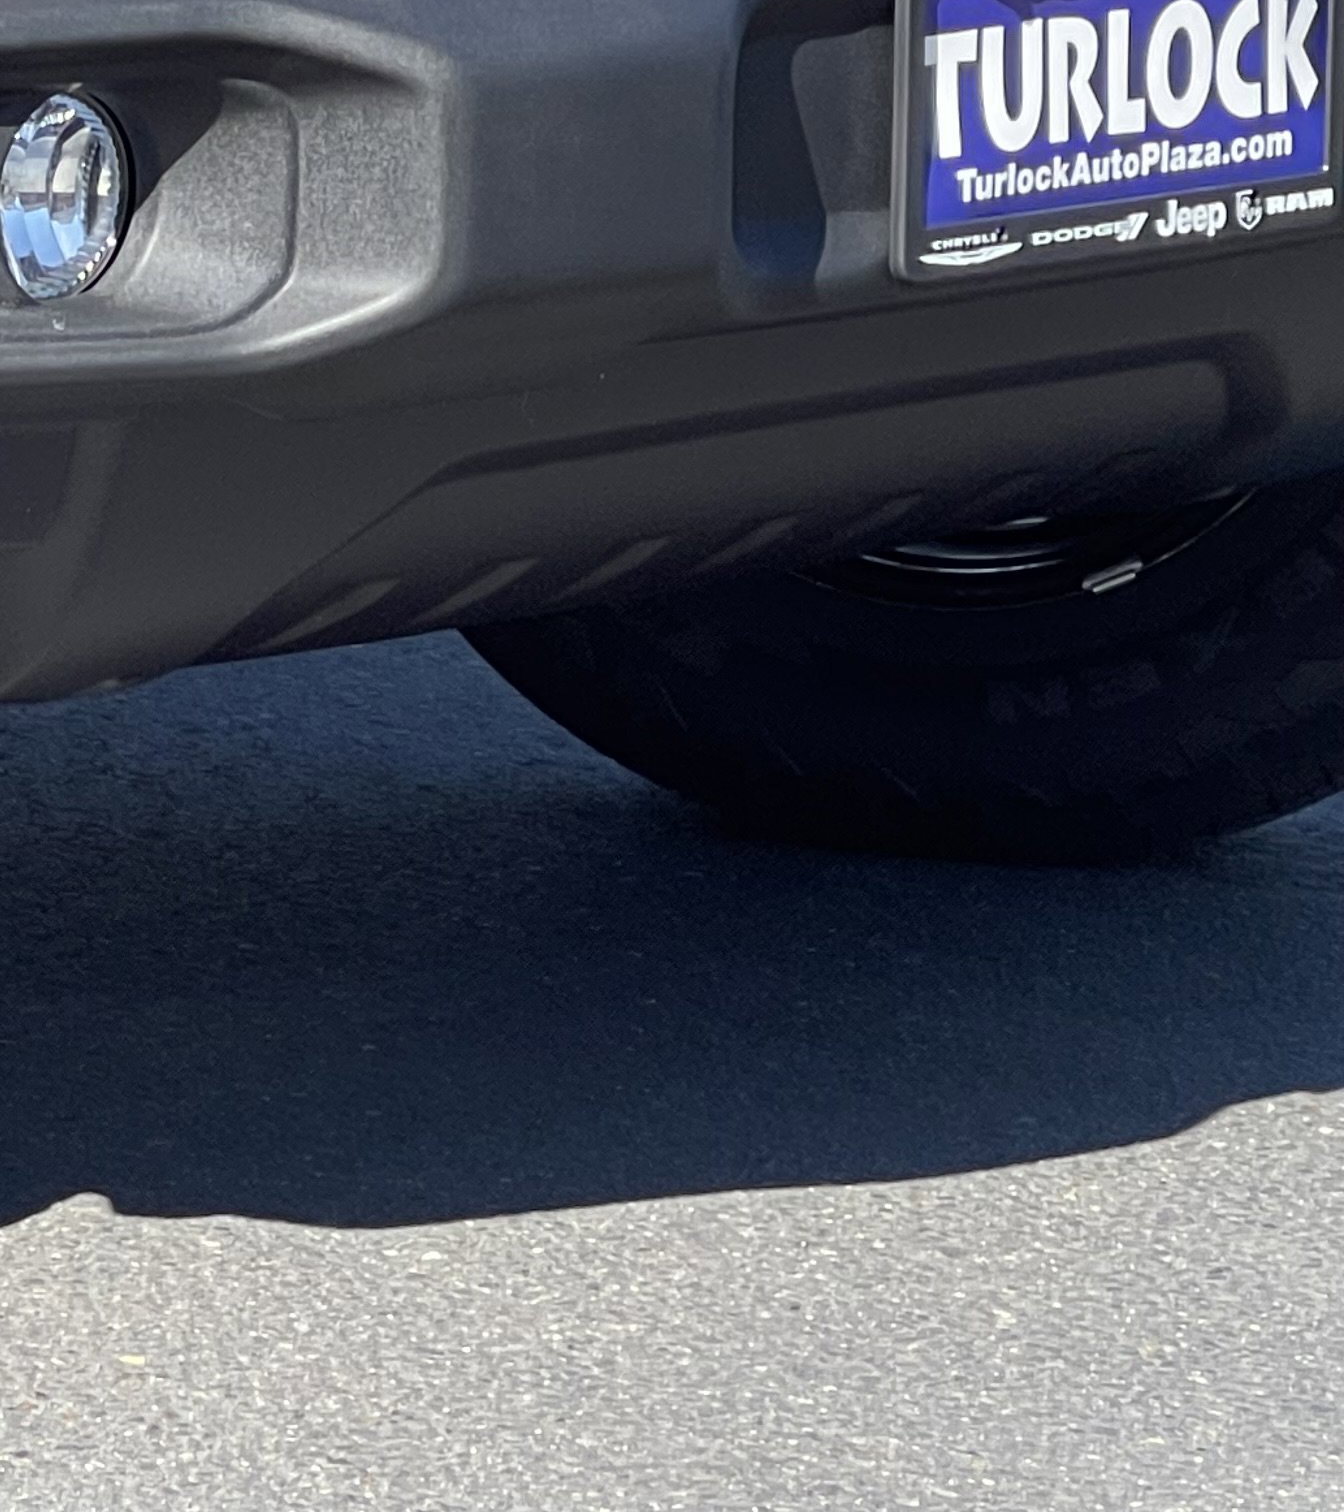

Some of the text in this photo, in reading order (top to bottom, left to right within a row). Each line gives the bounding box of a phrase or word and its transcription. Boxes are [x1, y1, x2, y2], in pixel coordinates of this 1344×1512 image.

[956, 129, 1293, 203] TurlockAutoPlaza.com
[1156, 199, 1227, 236] Jeep
[1266, 188, 1334, 215] RAM
